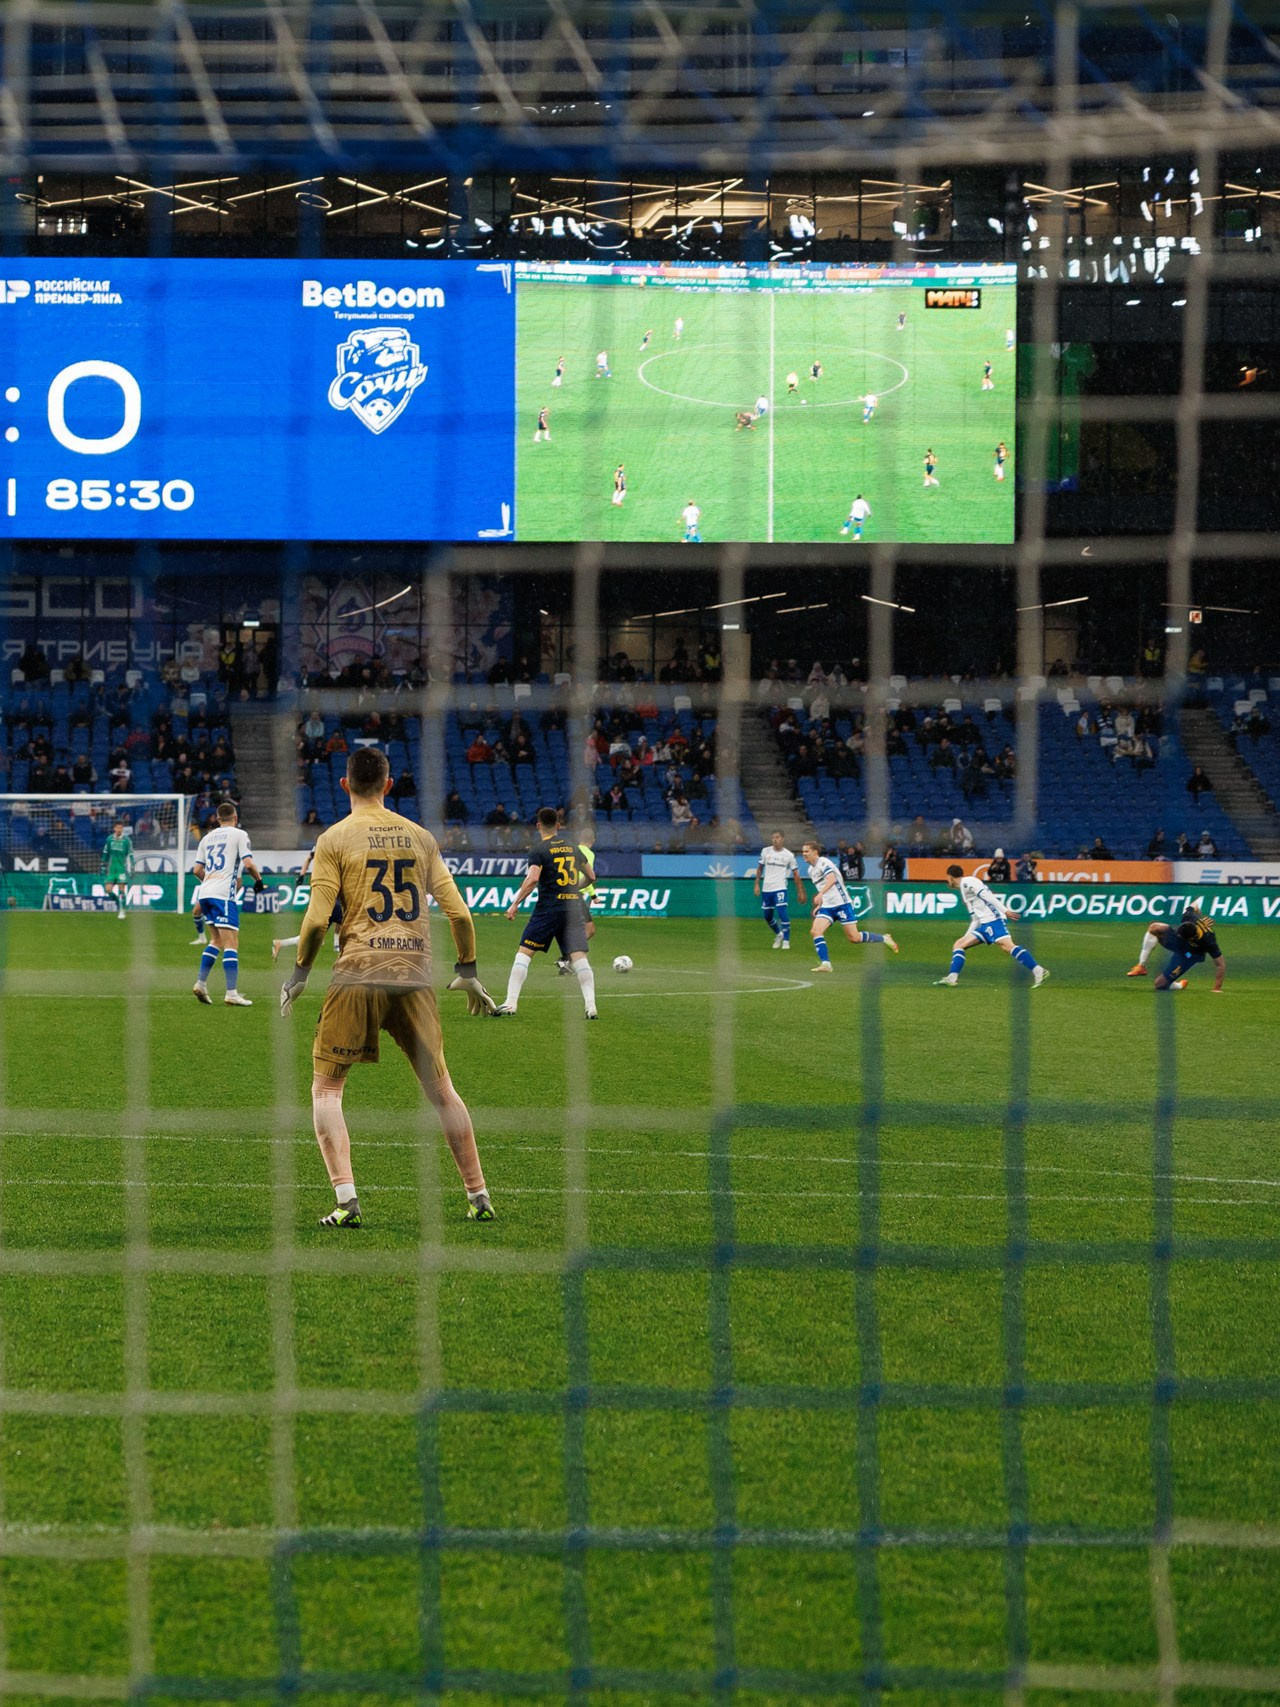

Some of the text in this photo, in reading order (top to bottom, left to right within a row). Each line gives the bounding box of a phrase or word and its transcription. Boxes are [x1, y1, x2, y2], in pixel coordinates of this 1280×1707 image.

[35, 278, 110, 292] РОССИЙСКАЯ
[302, 280, 445, 308] BetBoom
[35, 293, 123, 305] ПРЕМЬЕР-ЛИГА
[46, 478, 195, 511] 85:30
[37, 639, 204, 662] ТРИБУНА
[368, 834, 412, 850] ДЁГТЕВ
[206, 843, 227, 872] 33
[444, 857, 529, 875] БАЛТИ
[553, 856, 578, 886] 33
[366, 858, 420, 922] 35
[465, 886, 671, 910] VAMPET.RU
[256, 892, 280, 913] ВТБ
[886, 892, 958, 914] МИР
[1209, 896, 1249, 917] НА
[377, 938, 425, 951] SMP RACING
